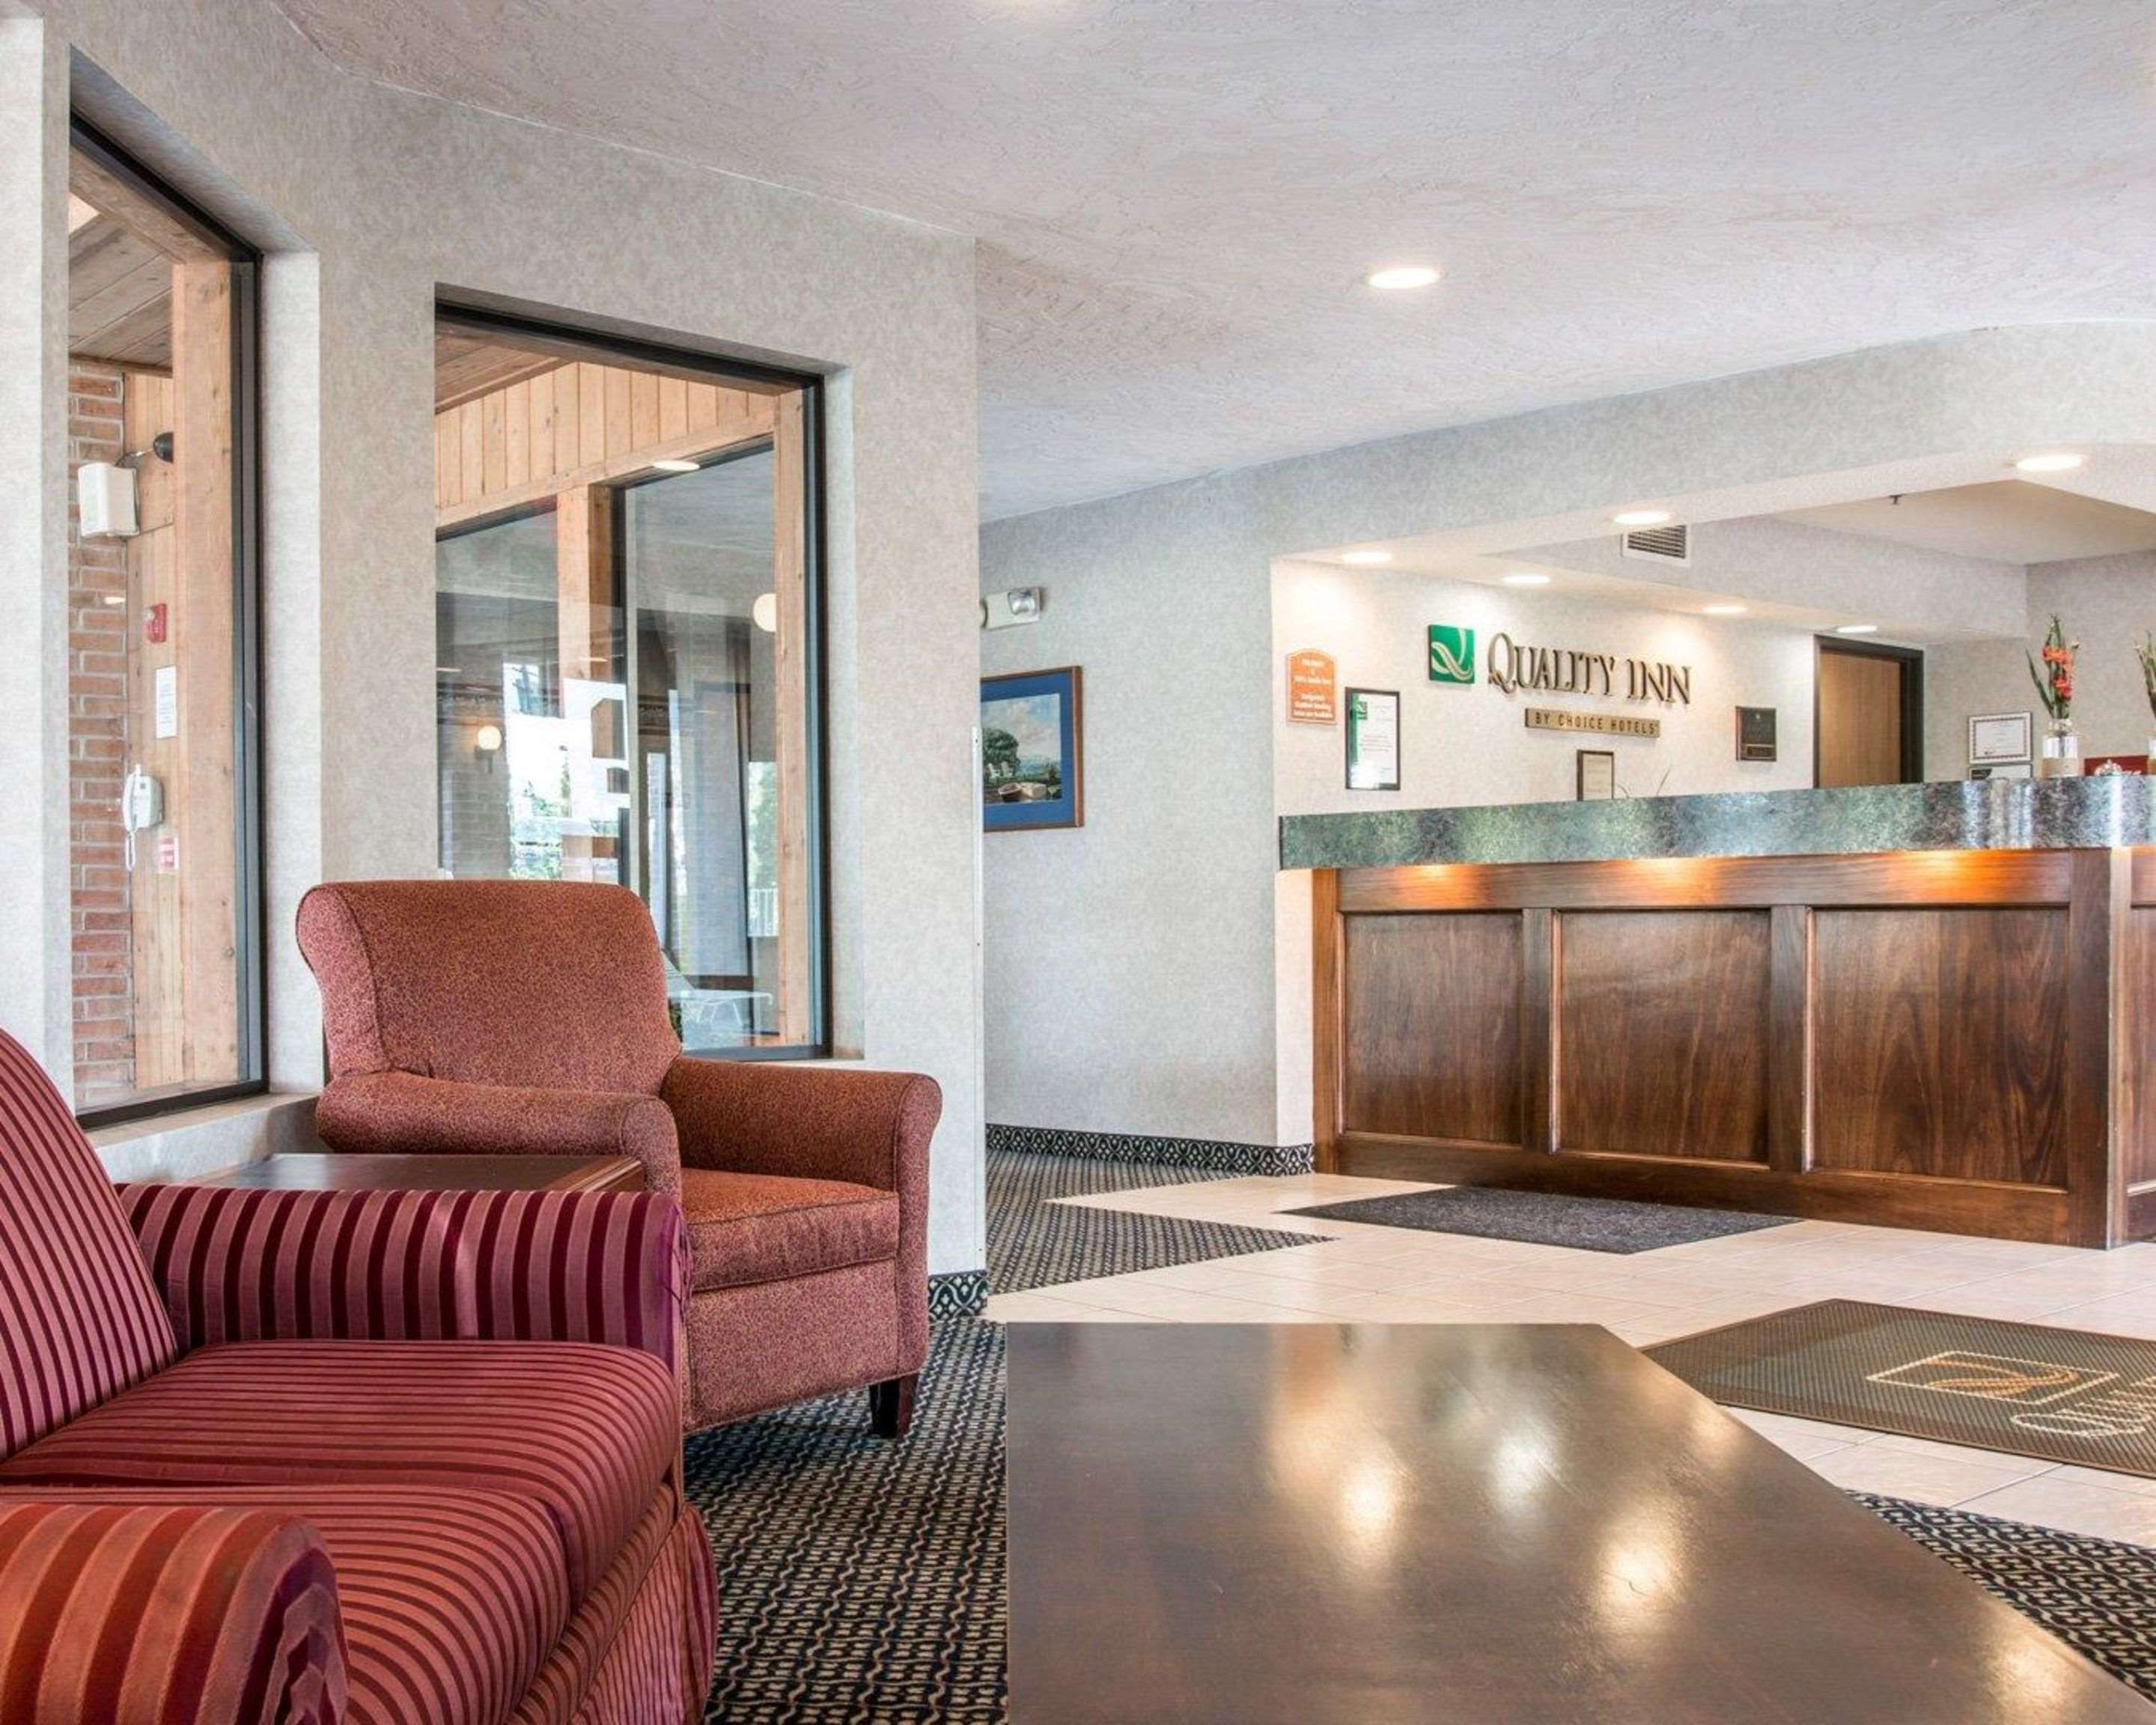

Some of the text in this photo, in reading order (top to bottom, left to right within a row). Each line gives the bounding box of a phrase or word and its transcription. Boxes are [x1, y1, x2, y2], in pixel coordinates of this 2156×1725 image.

[1487, 633, 1691, 704] QUALITY INN
[1536, 712, 1550, 725] BY
[1558, 714, 1604, 731] CHOICE
